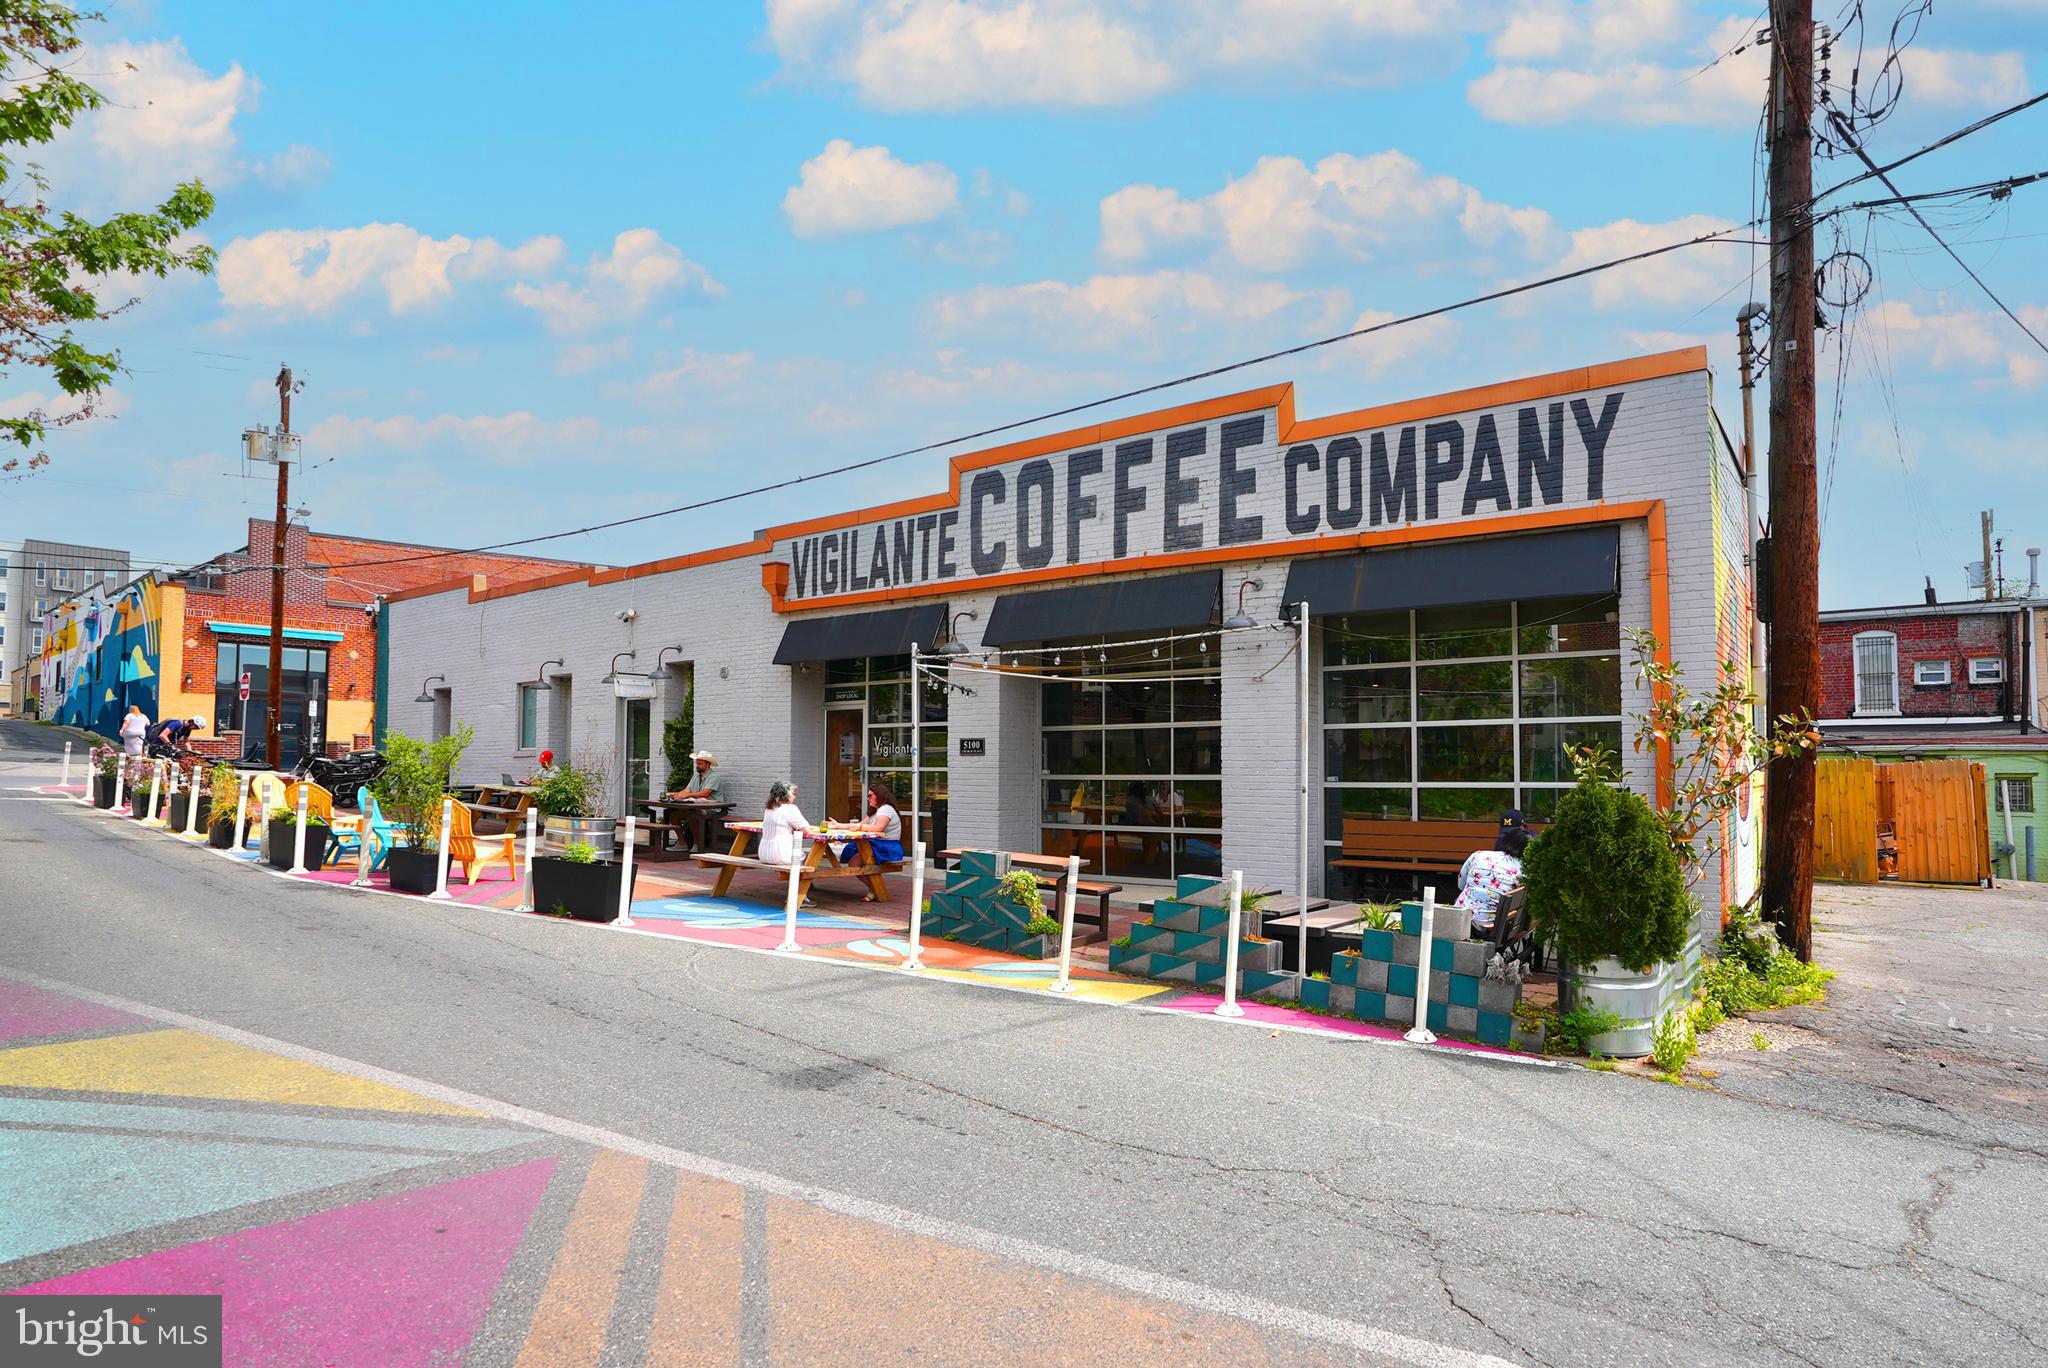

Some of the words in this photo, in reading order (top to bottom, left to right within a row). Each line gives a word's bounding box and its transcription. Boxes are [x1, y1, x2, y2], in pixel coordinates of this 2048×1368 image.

[792, 511, 959, 599] VIGILANTE
[970, 415, 1265, 576] COFFEE
[1284, 392, 1625, 535] COMPANY
[963, 740, 981, 750] 5100
[1503, 818, 1513, 826] M
